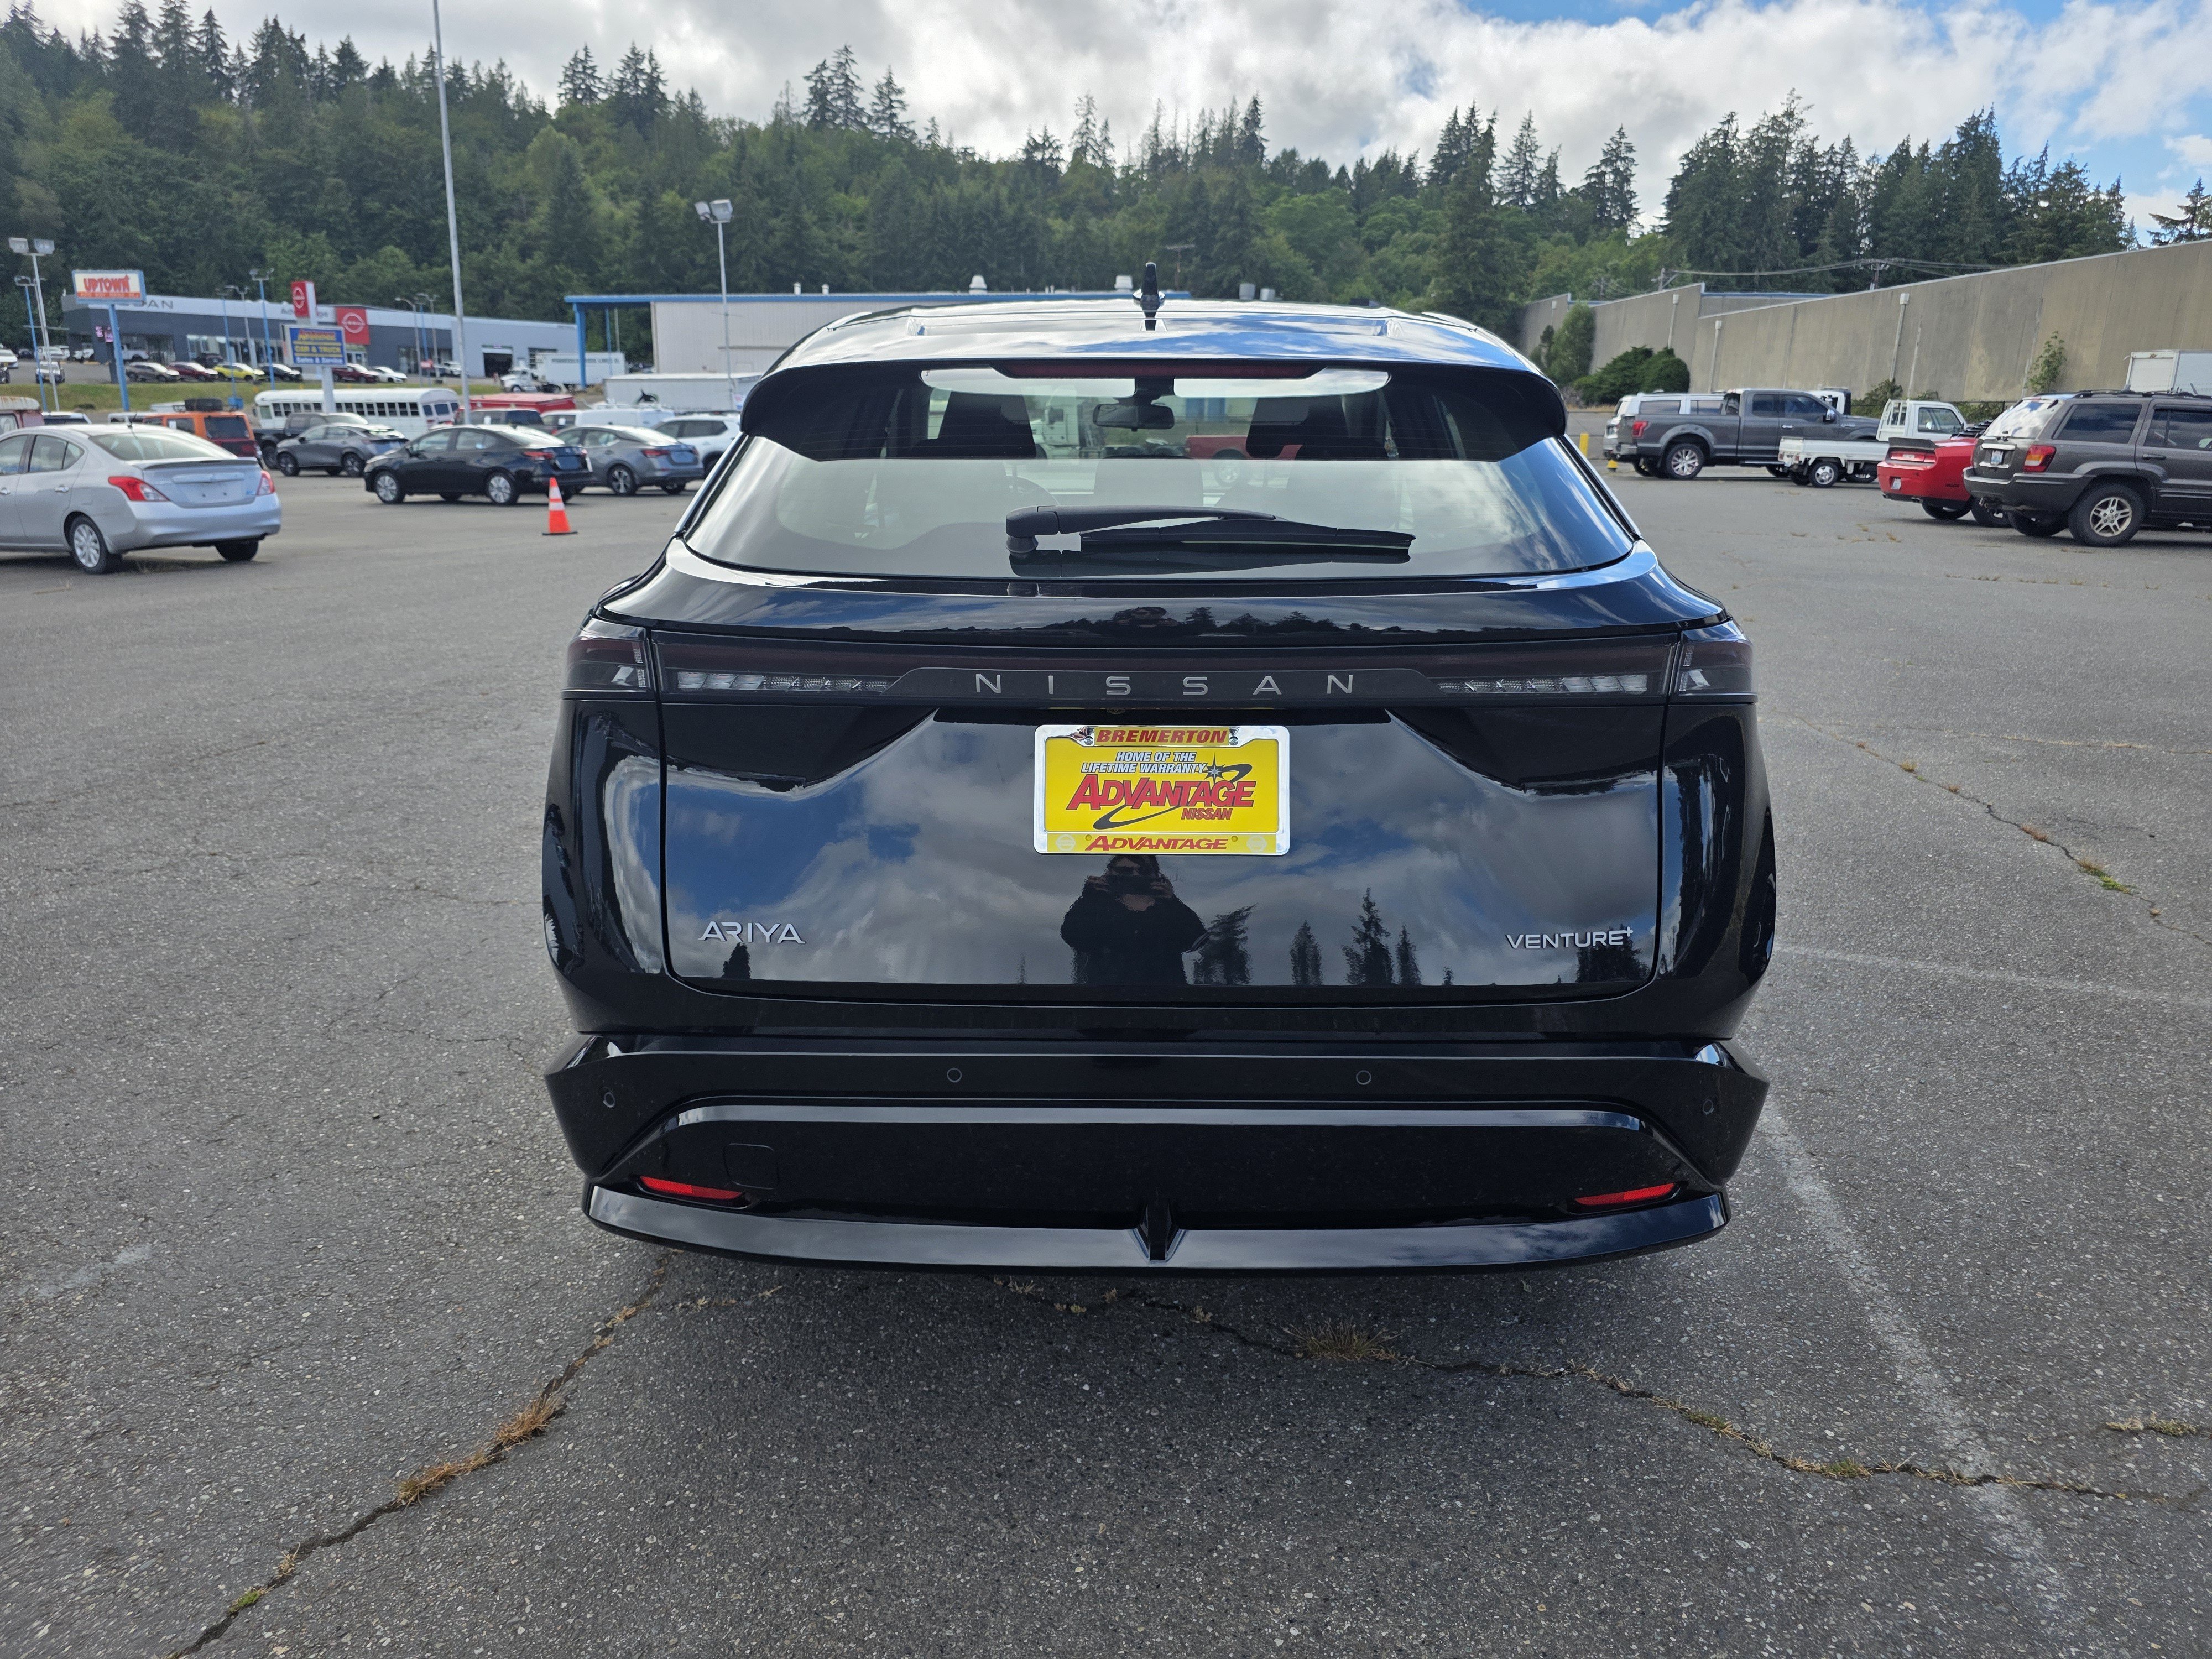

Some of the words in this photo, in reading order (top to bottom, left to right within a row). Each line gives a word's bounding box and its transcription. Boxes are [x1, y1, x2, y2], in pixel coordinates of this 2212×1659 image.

[84, 275, 130, 292] UPTOWN
[975, 674, 1353, 695] NISSAN
[1095, 730, 1228, 744] BREMERTON
[1115, 752, 1151, 761] HOME
[1154, 752, 1171, 761] OF
[1173, 752, 1197, 761] THE
[1081, 763, 1137, 773] LIFETIME
[1139, 763, 1207, 773] WARRANTY
[1065, 774, 1257, 810] ADVANTAGE
[1181, 808, 1233, 820] NISSAN
[1084, 835, 1229, 851] ADVANTAGE
[697, 921, 806, 944] ARIYA
